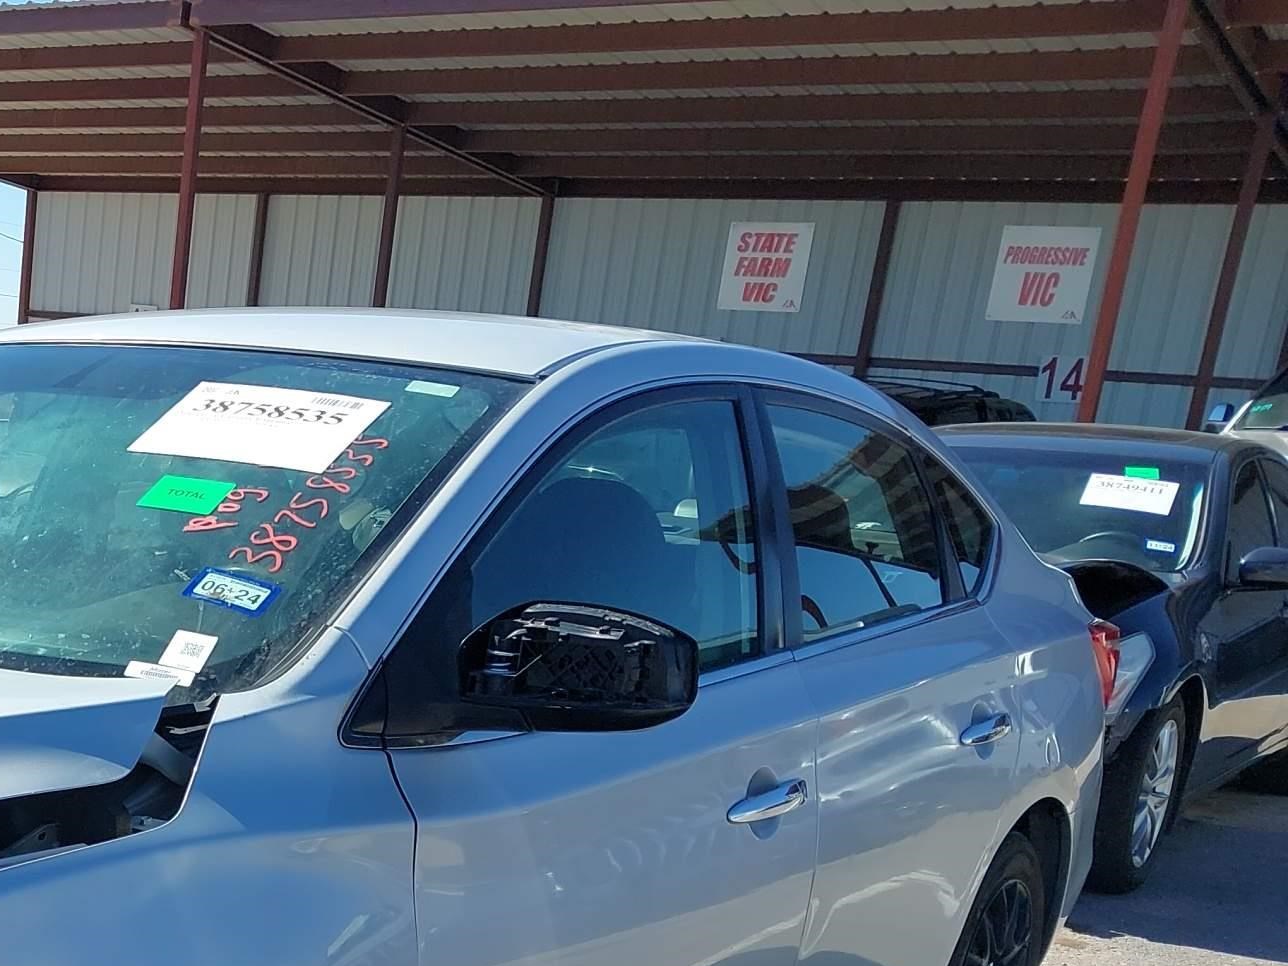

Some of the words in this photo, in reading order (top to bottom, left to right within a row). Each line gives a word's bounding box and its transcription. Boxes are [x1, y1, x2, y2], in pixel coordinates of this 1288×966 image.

[737, 231, 799, 253] STATE
[1003, 245, 1090, 266] PROGRESSIVE
[734, 256, 792, 278] FARM
[742, 282, 778, 303] VIC
[1018, 271, 1060, 307] VIC
[1041, 356, 1084, 401] 14
[192, 398, 349, 425] 38758535
[167, 488, 206, 500] TOTAL
